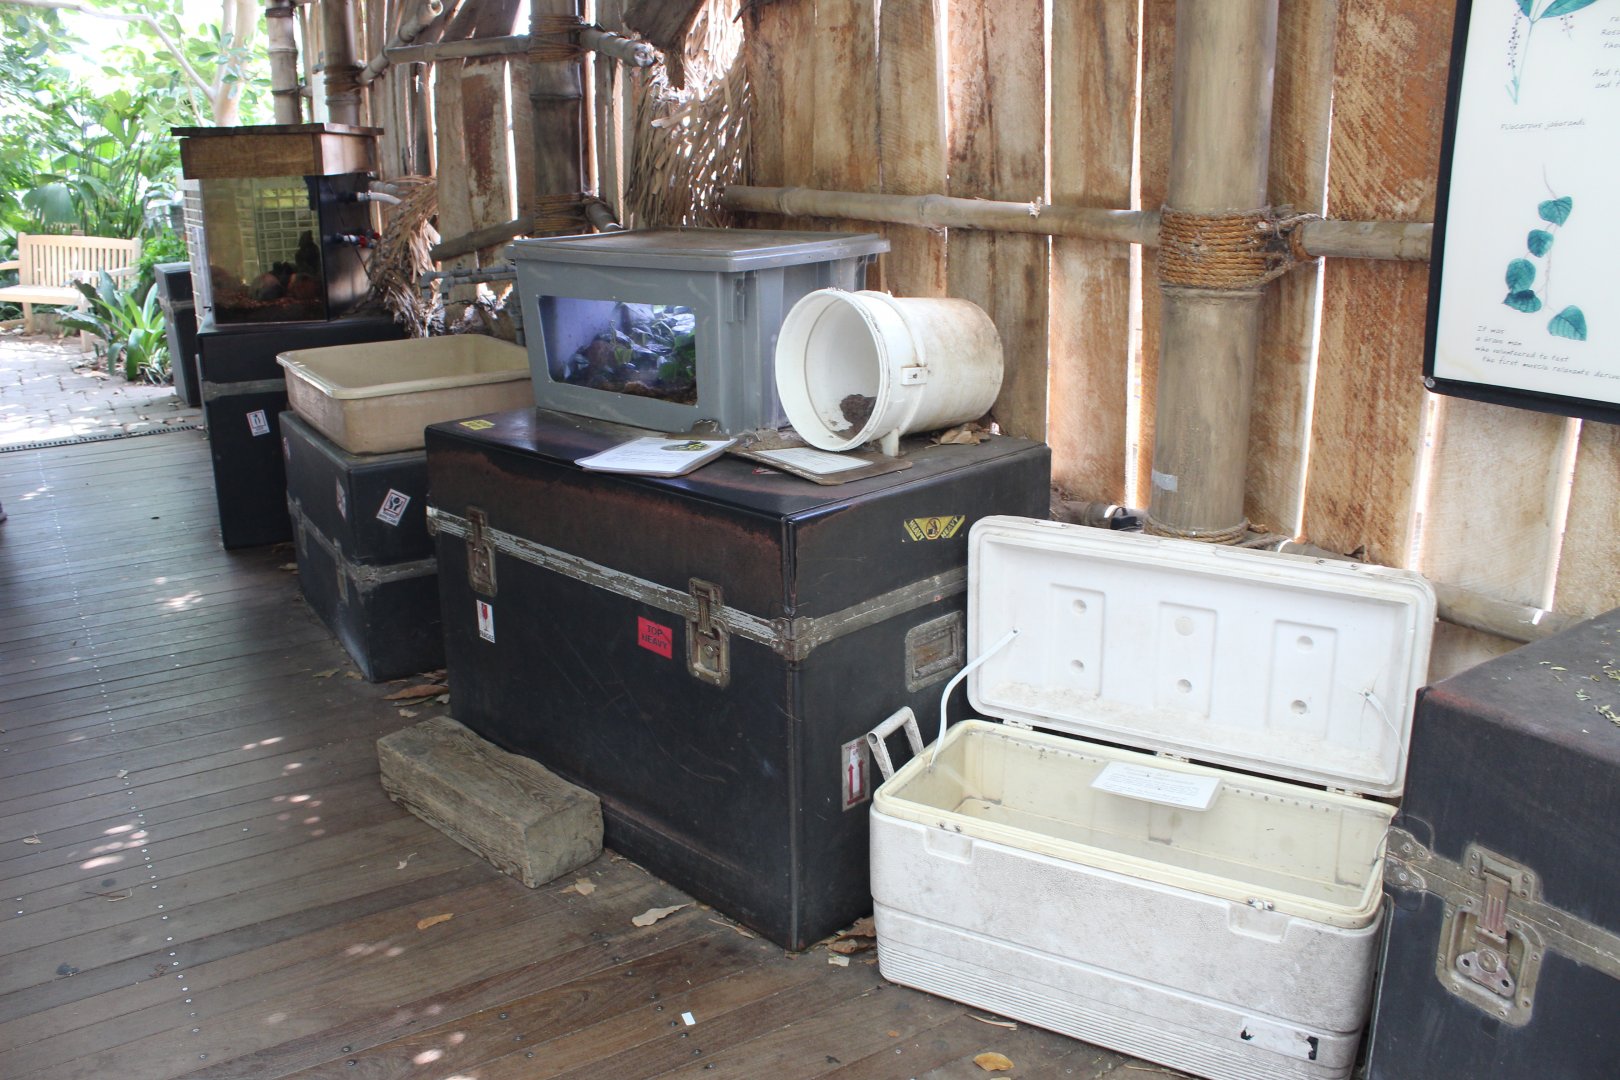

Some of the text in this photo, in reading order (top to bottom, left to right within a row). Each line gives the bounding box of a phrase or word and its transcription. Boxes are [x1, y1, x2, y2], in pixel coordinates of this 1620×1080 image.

[908, 519, 925, 541] HEAVY
[940, 515, 959, 539] HEAVY
[647, 625, 663, 636] TOP
[642, 634, 667, 649] HEAVY
